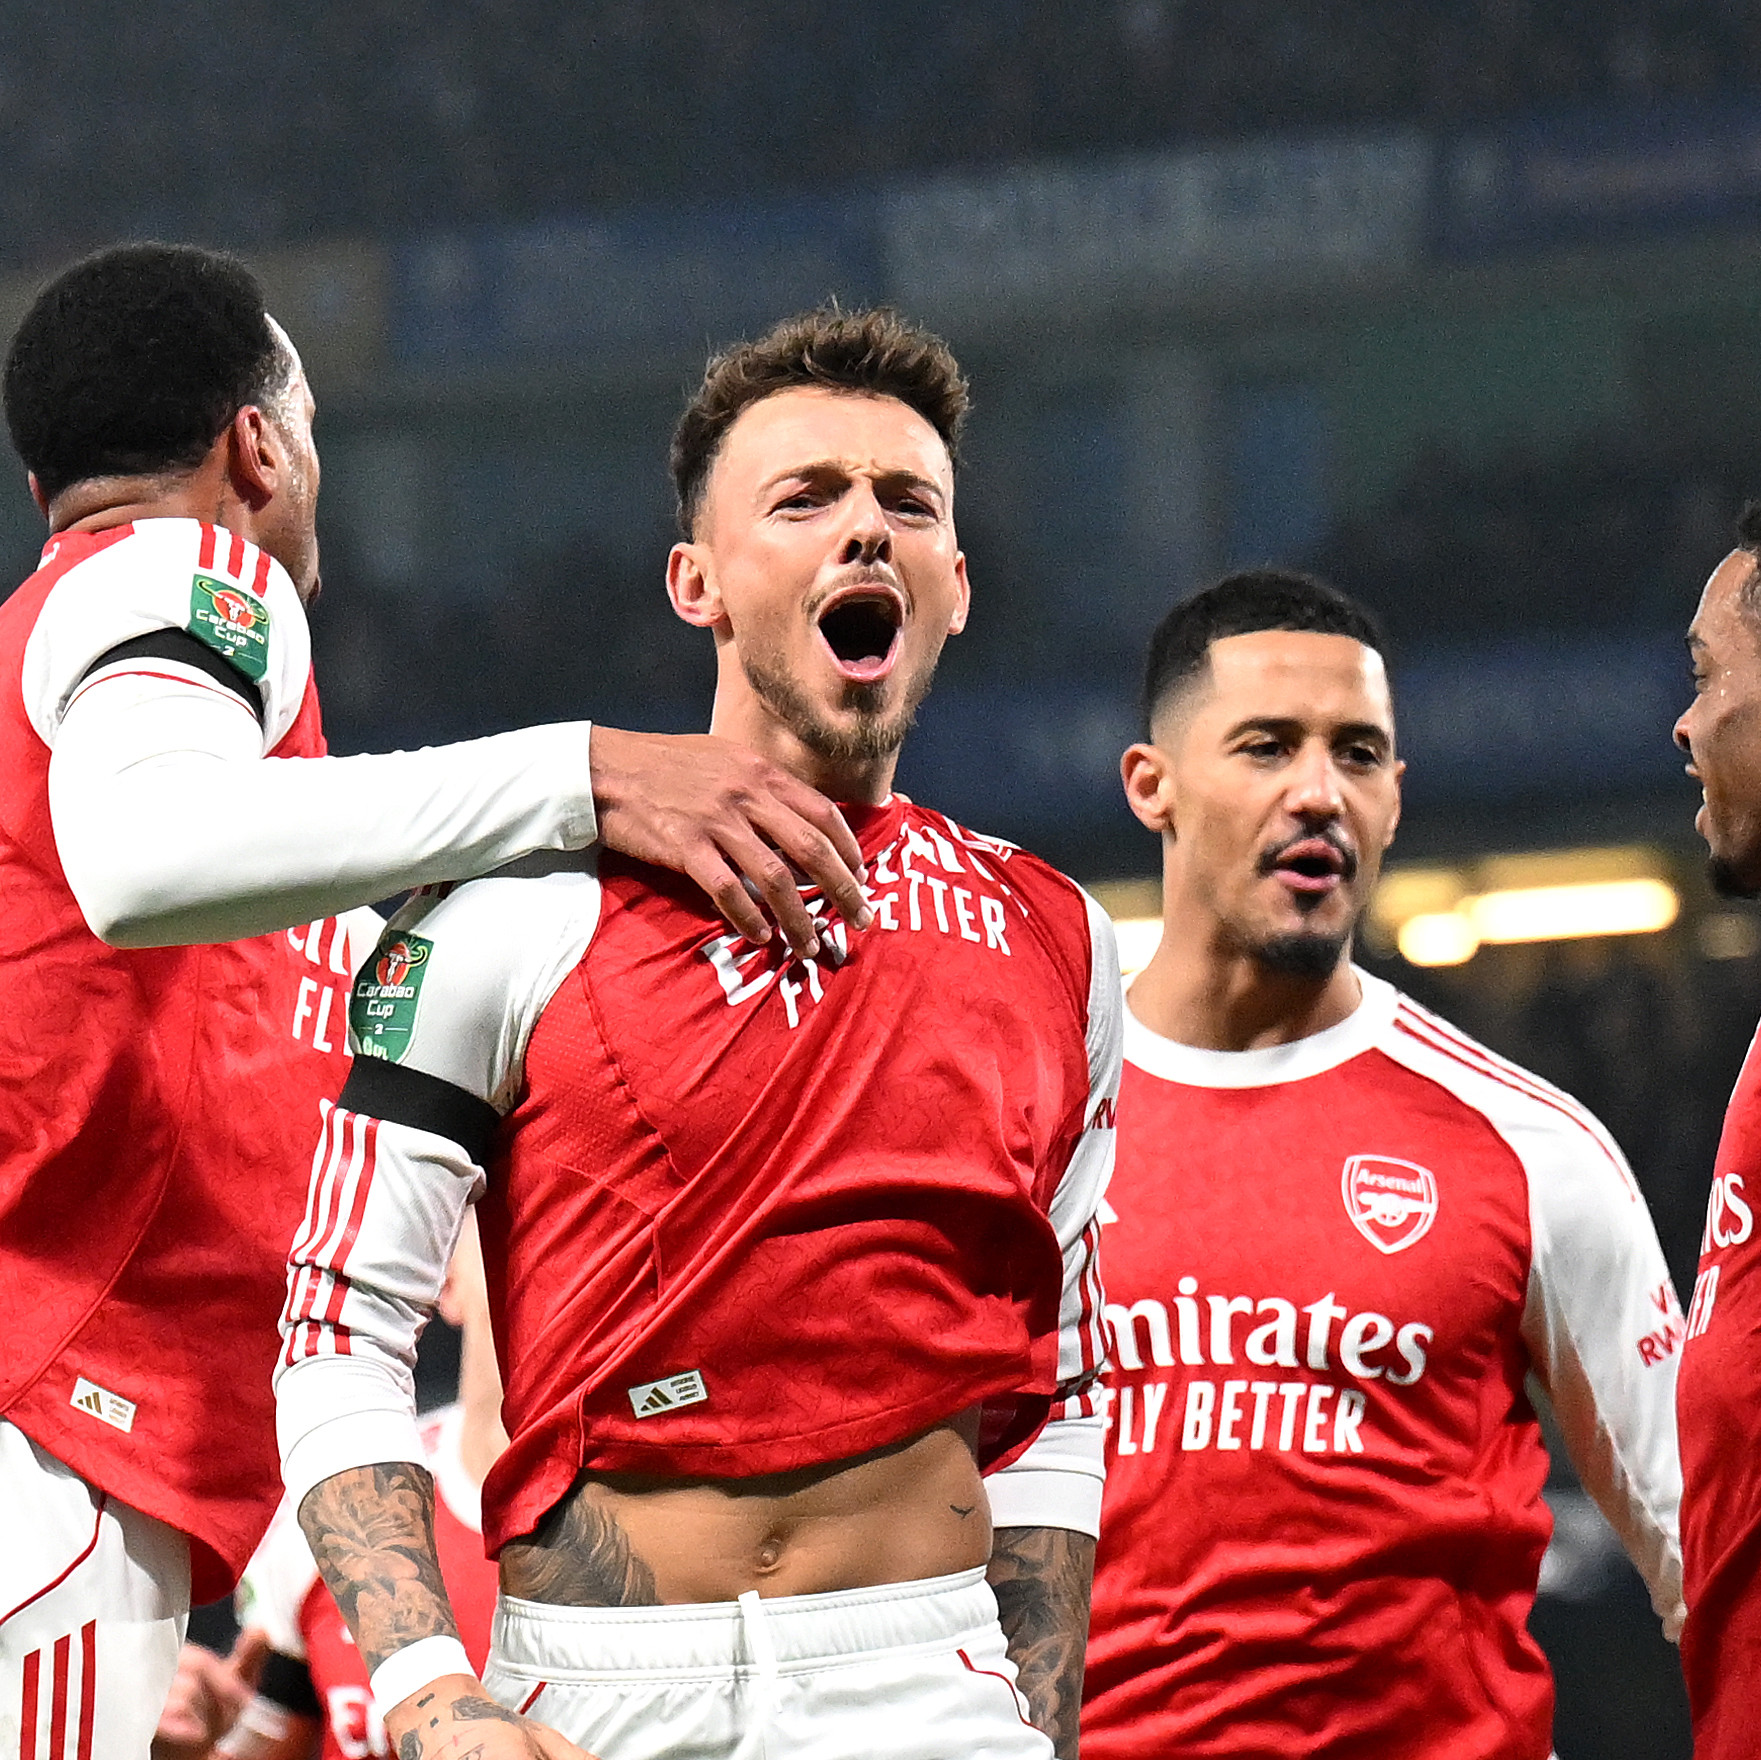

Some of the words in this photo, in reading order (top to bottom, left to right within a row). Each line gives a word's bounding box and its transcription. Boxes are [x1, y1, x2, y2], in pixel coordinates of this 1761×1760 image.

[196, 608, 265, 645] Carabao
[215, 625, 247, 647] Cup
[862, 868, 1012, 957] ETTER
[356, 982, 415, 999] Carabao
[366, 1000, 395, 1018] Cup
[292, 975, 354, 1057] FL
[1357, 1168, 1424, 1194] Arsenal
[1101, 1276, 1435, 1387] mirates
[1181, 1380, 1367, 1454] BETTER
